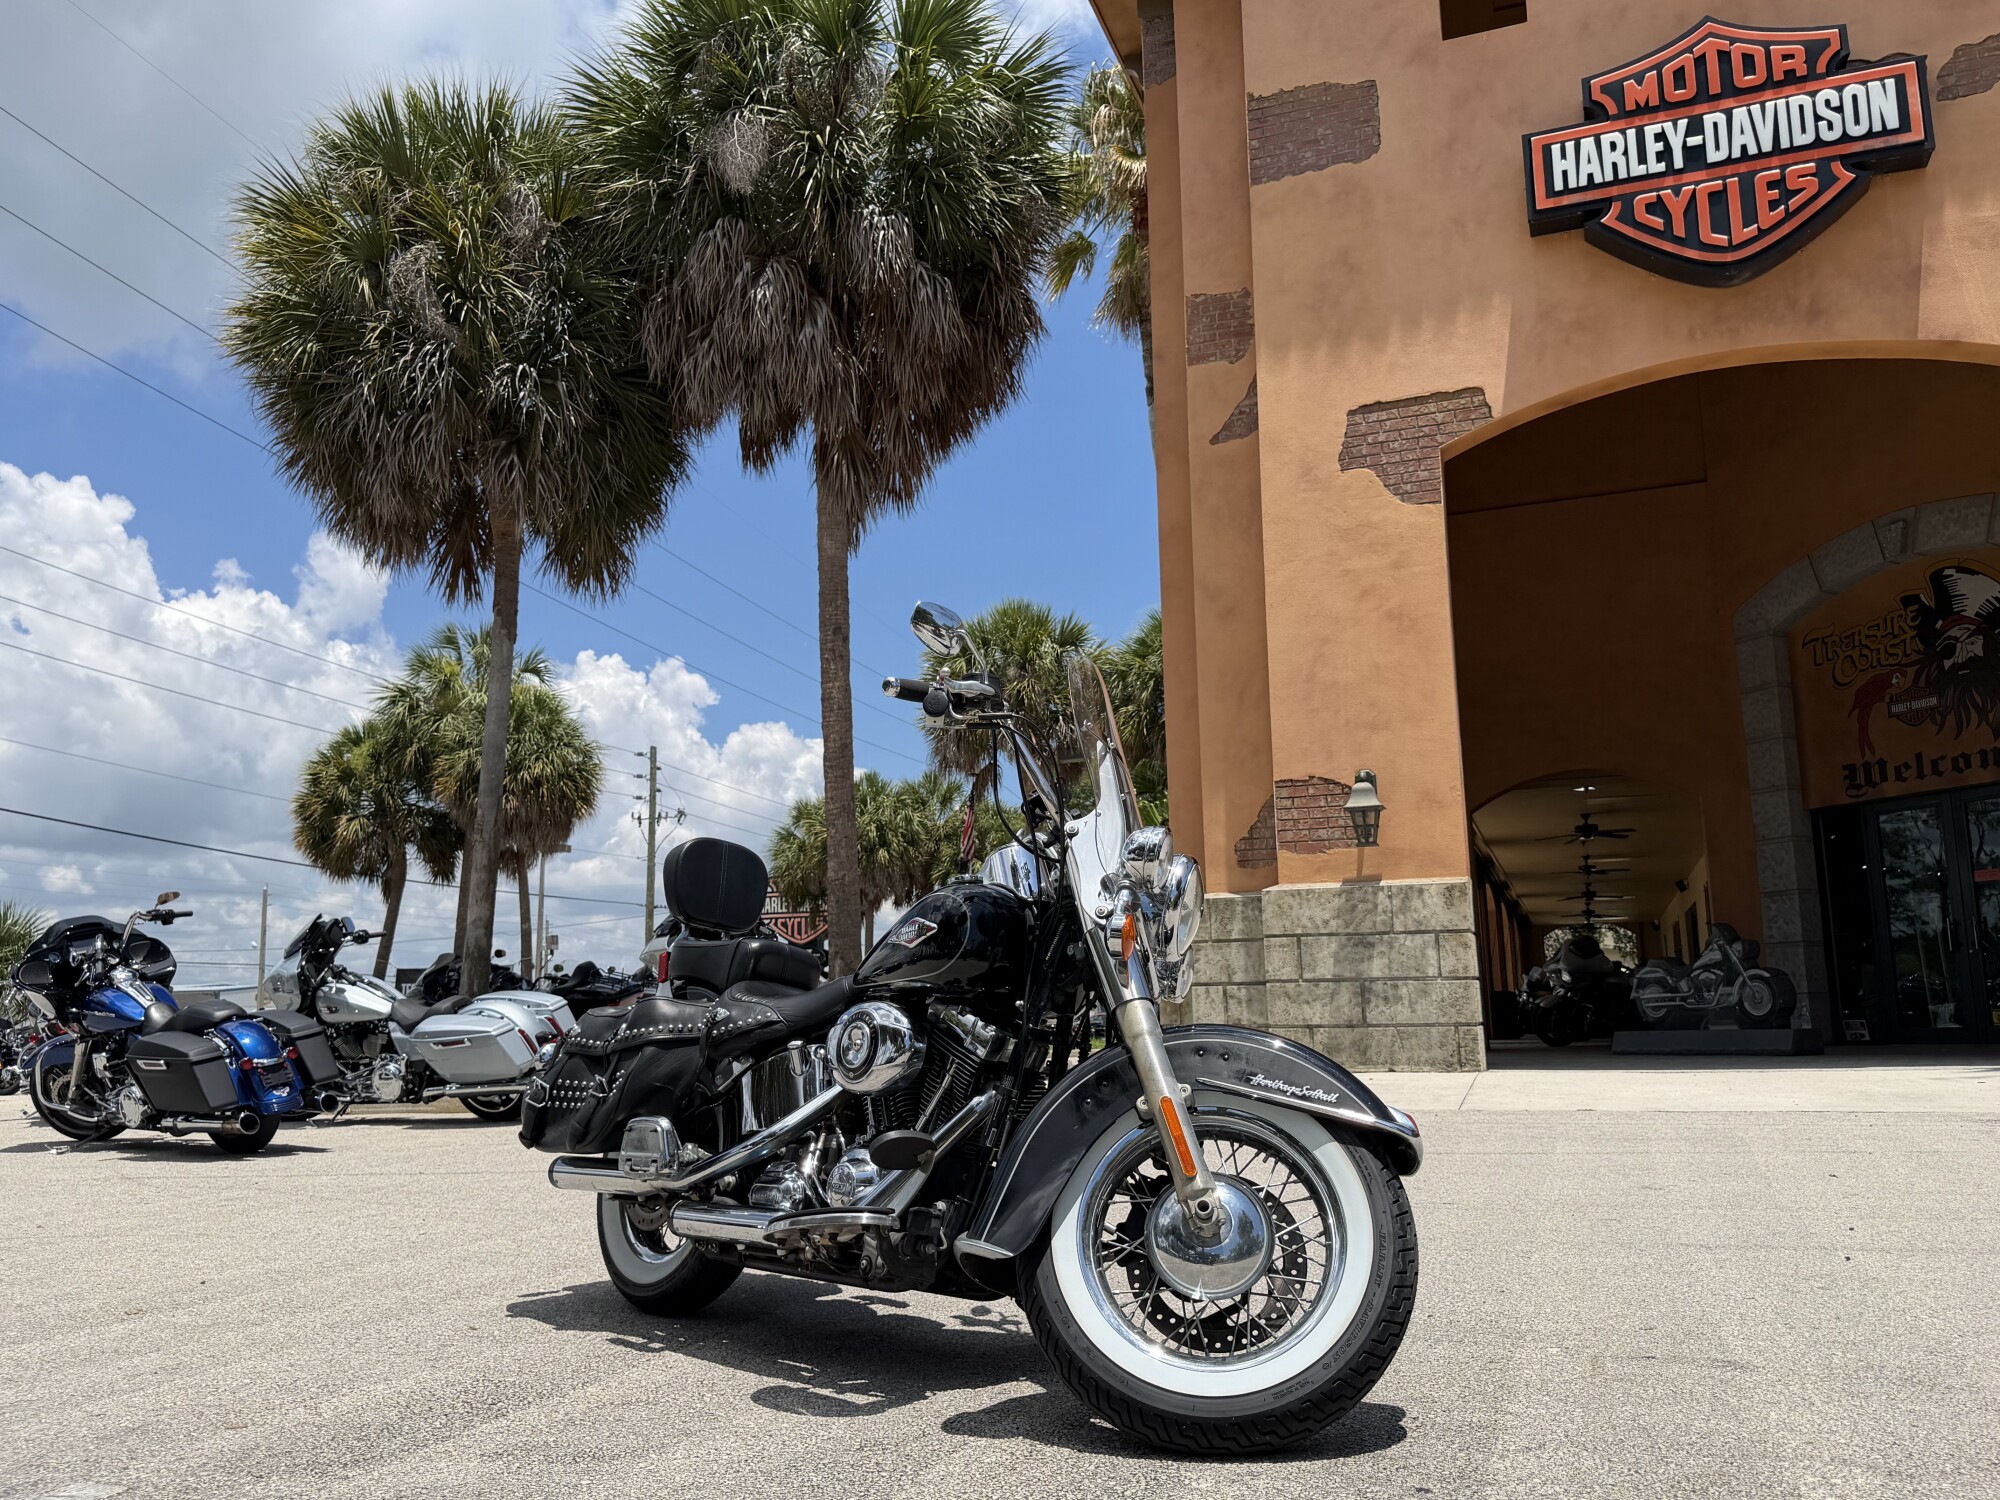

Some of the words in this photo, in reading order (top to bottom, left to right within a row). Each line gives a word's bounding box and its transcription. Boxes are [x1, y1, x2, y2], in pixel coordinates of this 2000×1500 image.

[1623, 37, 1807, 111] MOTOR
[1551, 78, 1900, 192] HARLEY-DAVIDSON
[1633, 163, 1819, 247] CYCLES
[1802, 604, 1921, 667] TREASURE
[1833, 631, 1920, 687] COAST
[1891, 696, 1938, 713] HARLEY-DAVIDSON
